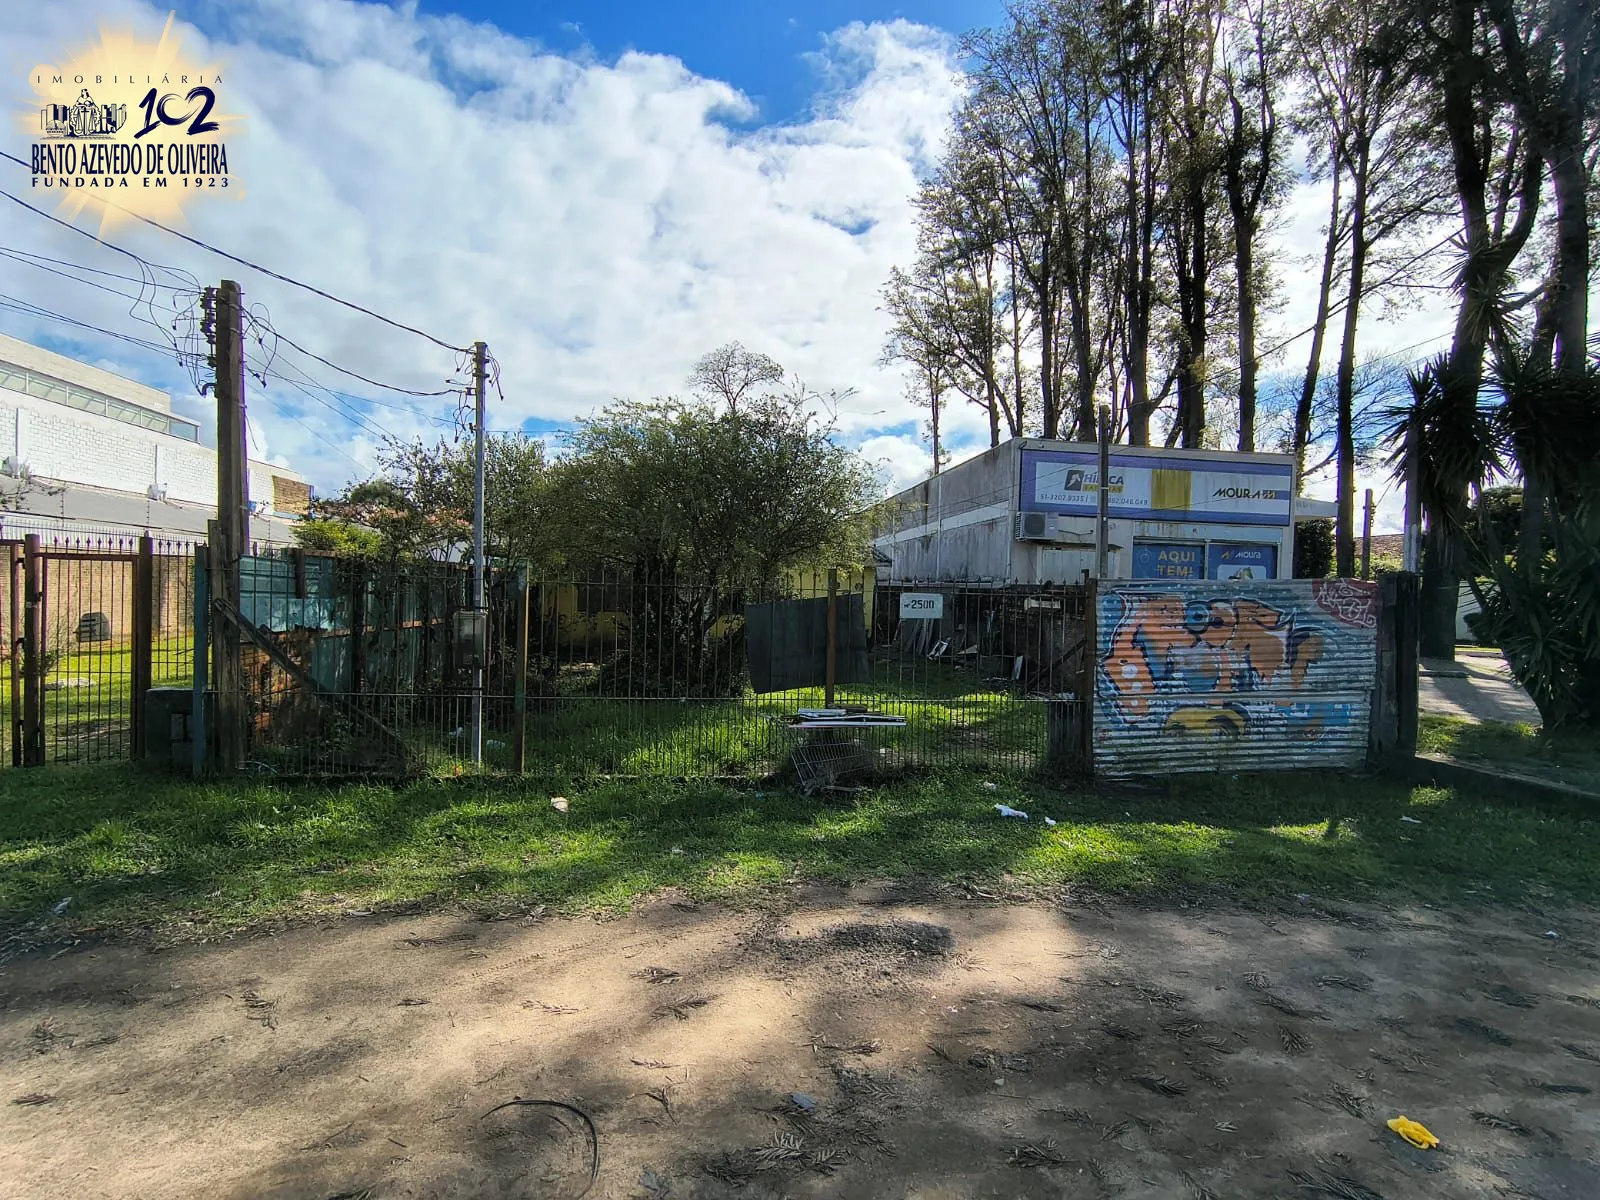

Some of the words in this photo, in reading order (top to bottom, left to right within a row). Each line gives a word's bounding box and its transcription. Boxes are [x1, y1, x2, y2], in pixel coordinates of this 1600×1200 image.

[1212, 487, 1261, 499] MOURA
[1158, 550, 1195, 563] AQUI
[1158, 565, 1193, 576] TEM!
[911, 599, 935, 609] 2500
